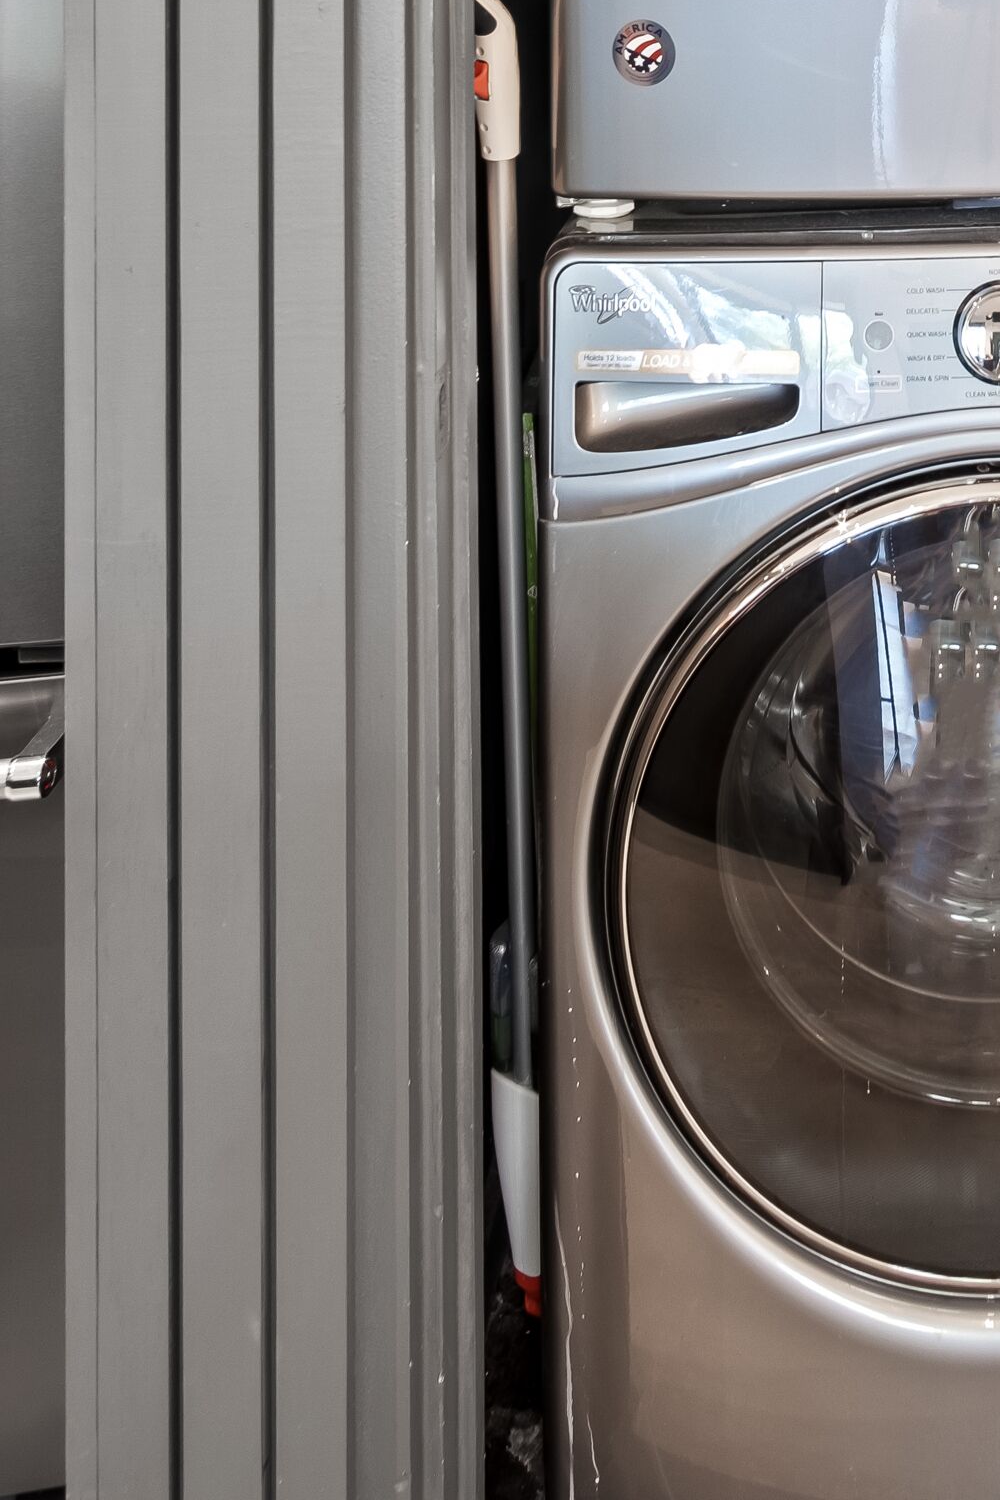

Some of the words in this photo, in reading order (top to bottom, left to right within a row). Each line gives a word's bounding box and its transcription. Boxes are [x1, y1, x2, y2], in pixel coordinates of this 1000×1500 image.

[614, 22, 663, 56] AMERICA
[905, 307, 940, 315] DELICATES
[616, 354, 636, 362] loads
[642, 354, 680, 368] LOAD
[965, 390, 986, 398] CLEAN
